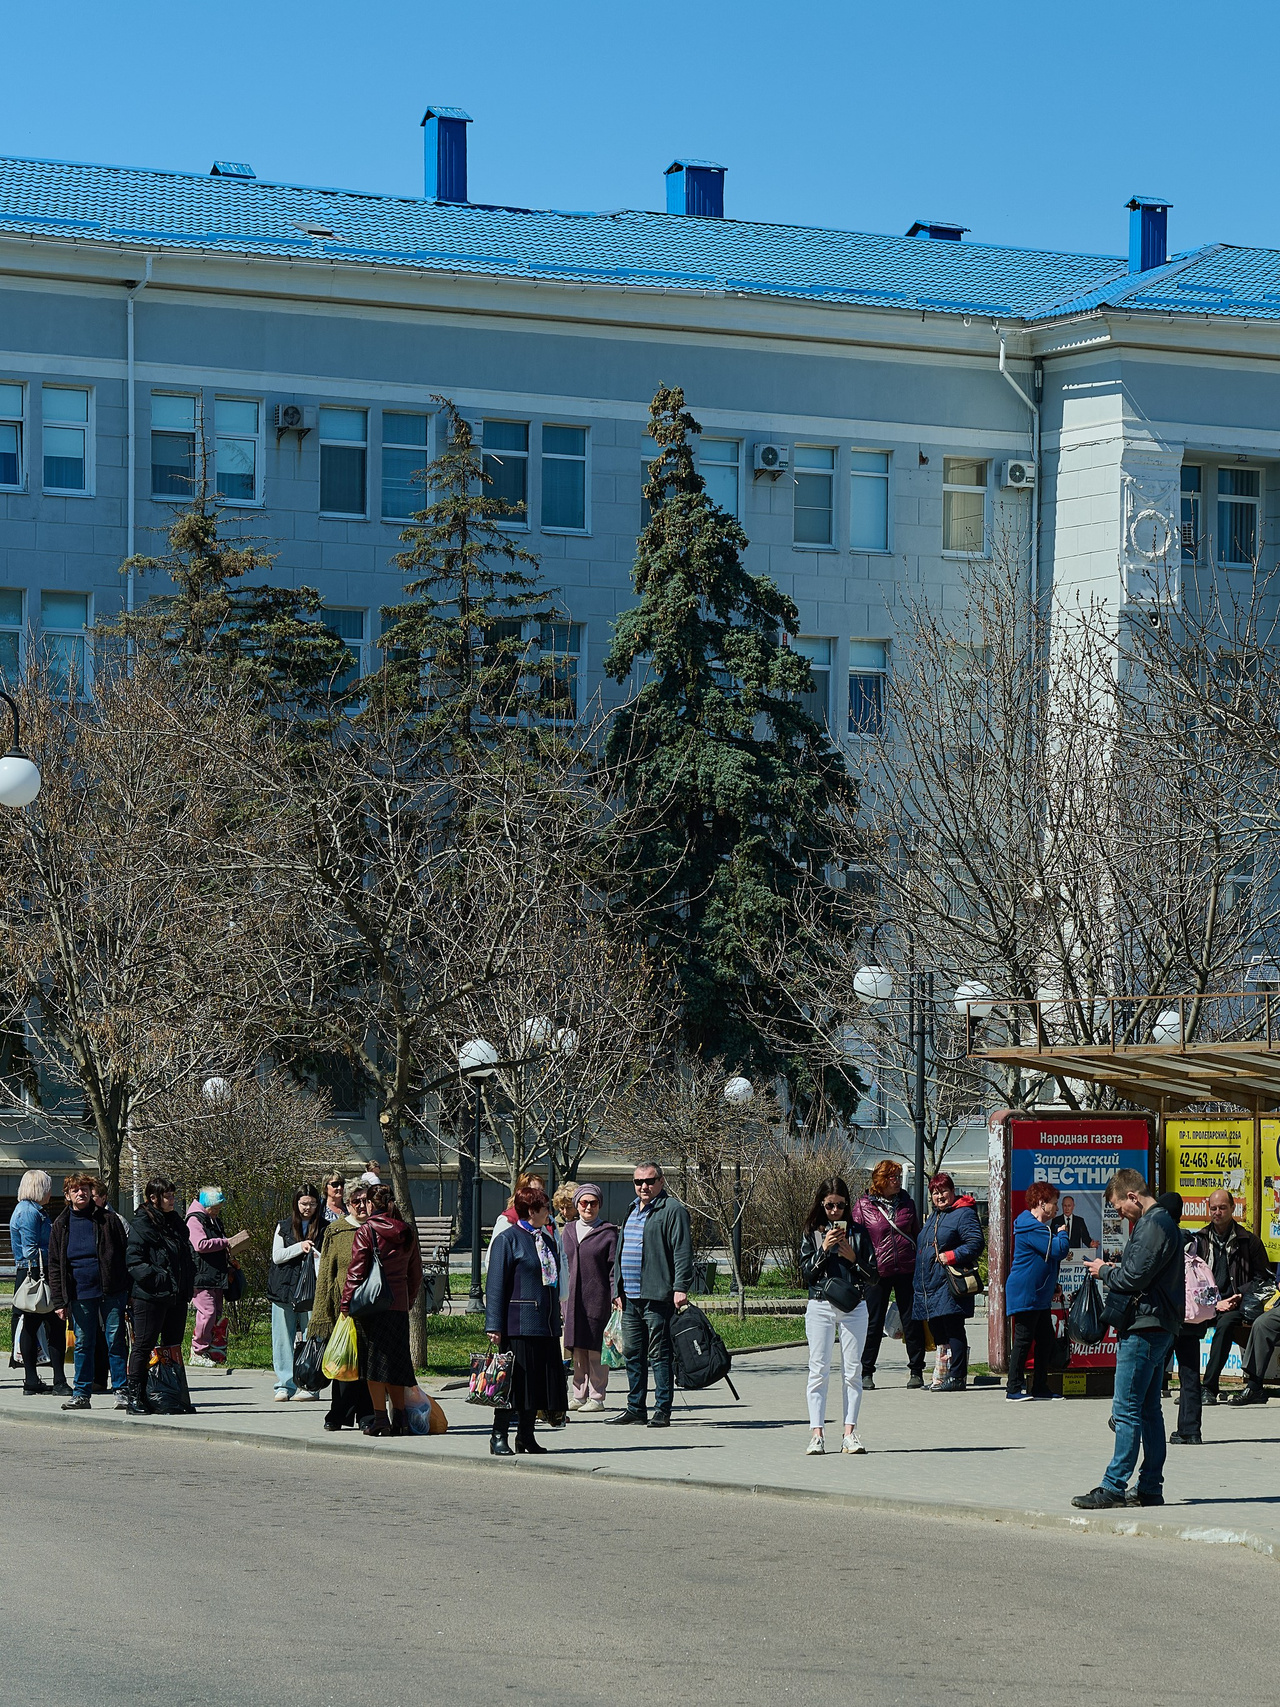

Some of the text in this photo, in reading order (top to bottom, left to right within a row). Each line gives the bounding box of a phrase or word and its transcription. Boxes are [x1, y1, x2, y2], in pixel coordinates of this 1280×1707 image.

[1040, 1132, 1123, 1146] Народная газета
[1034, 1153, 1120, 1168] Запорожский
[1180, 1152, 1242, 1168] 42-463 42-604
[1034, 1167, 1121, 1185] ВЕСТНИ
[1058, 1274, 1072, 1284] ДНА
